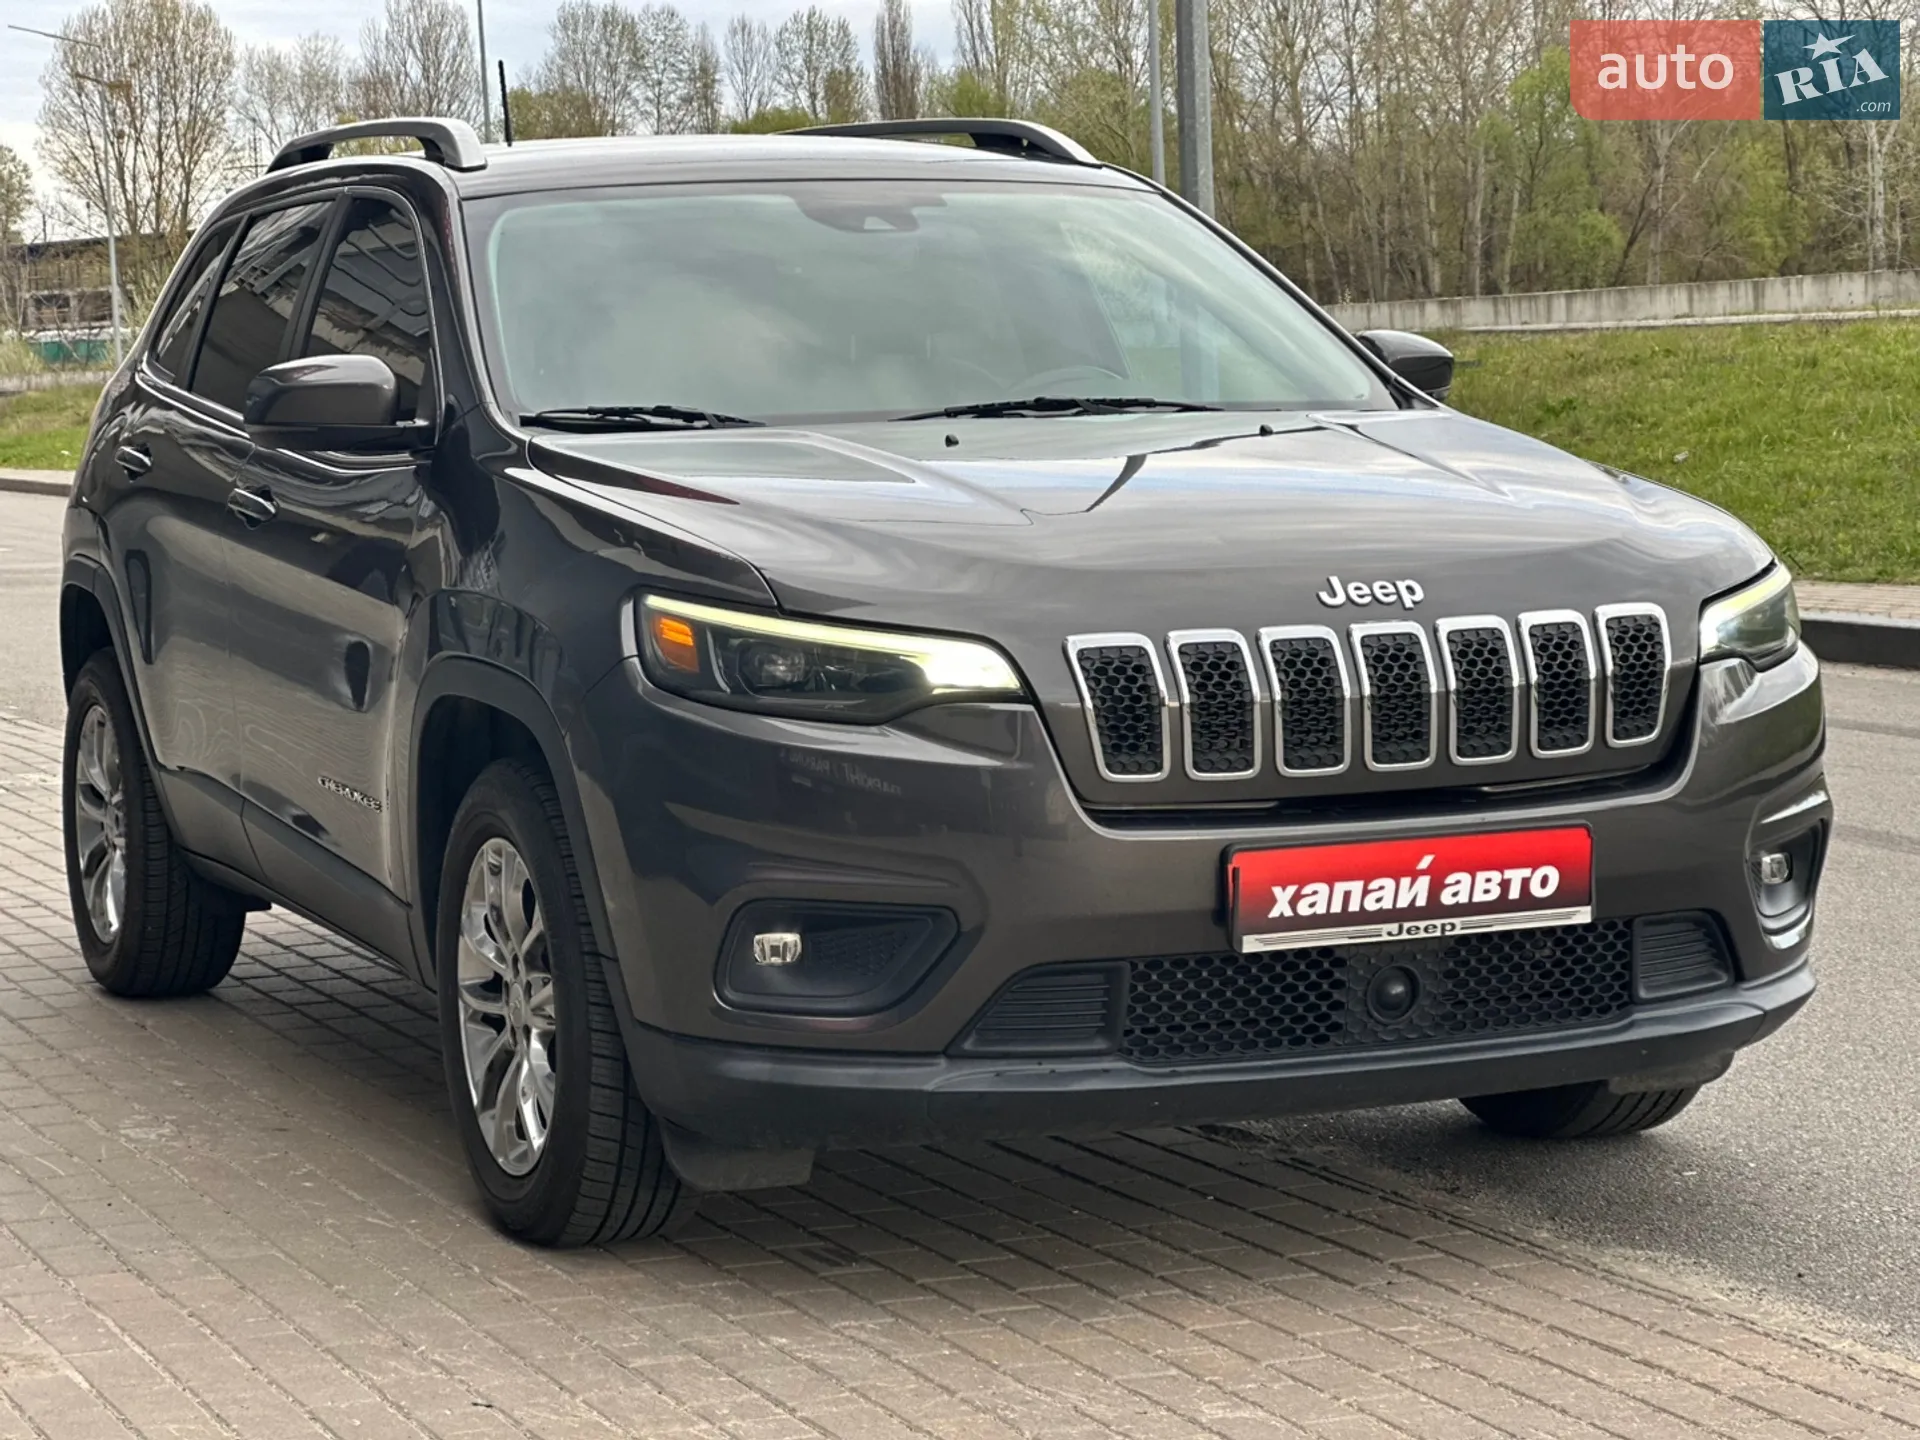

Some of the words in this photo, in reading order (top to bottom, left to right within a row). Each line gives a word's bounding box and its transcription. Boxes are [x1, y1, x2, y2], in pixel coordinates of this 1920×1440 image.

[1317, 575, 1424, 610] Jeep
[1440, 865, 1560, 905] авто
[1386, 922, 1457, 937] Jeep
